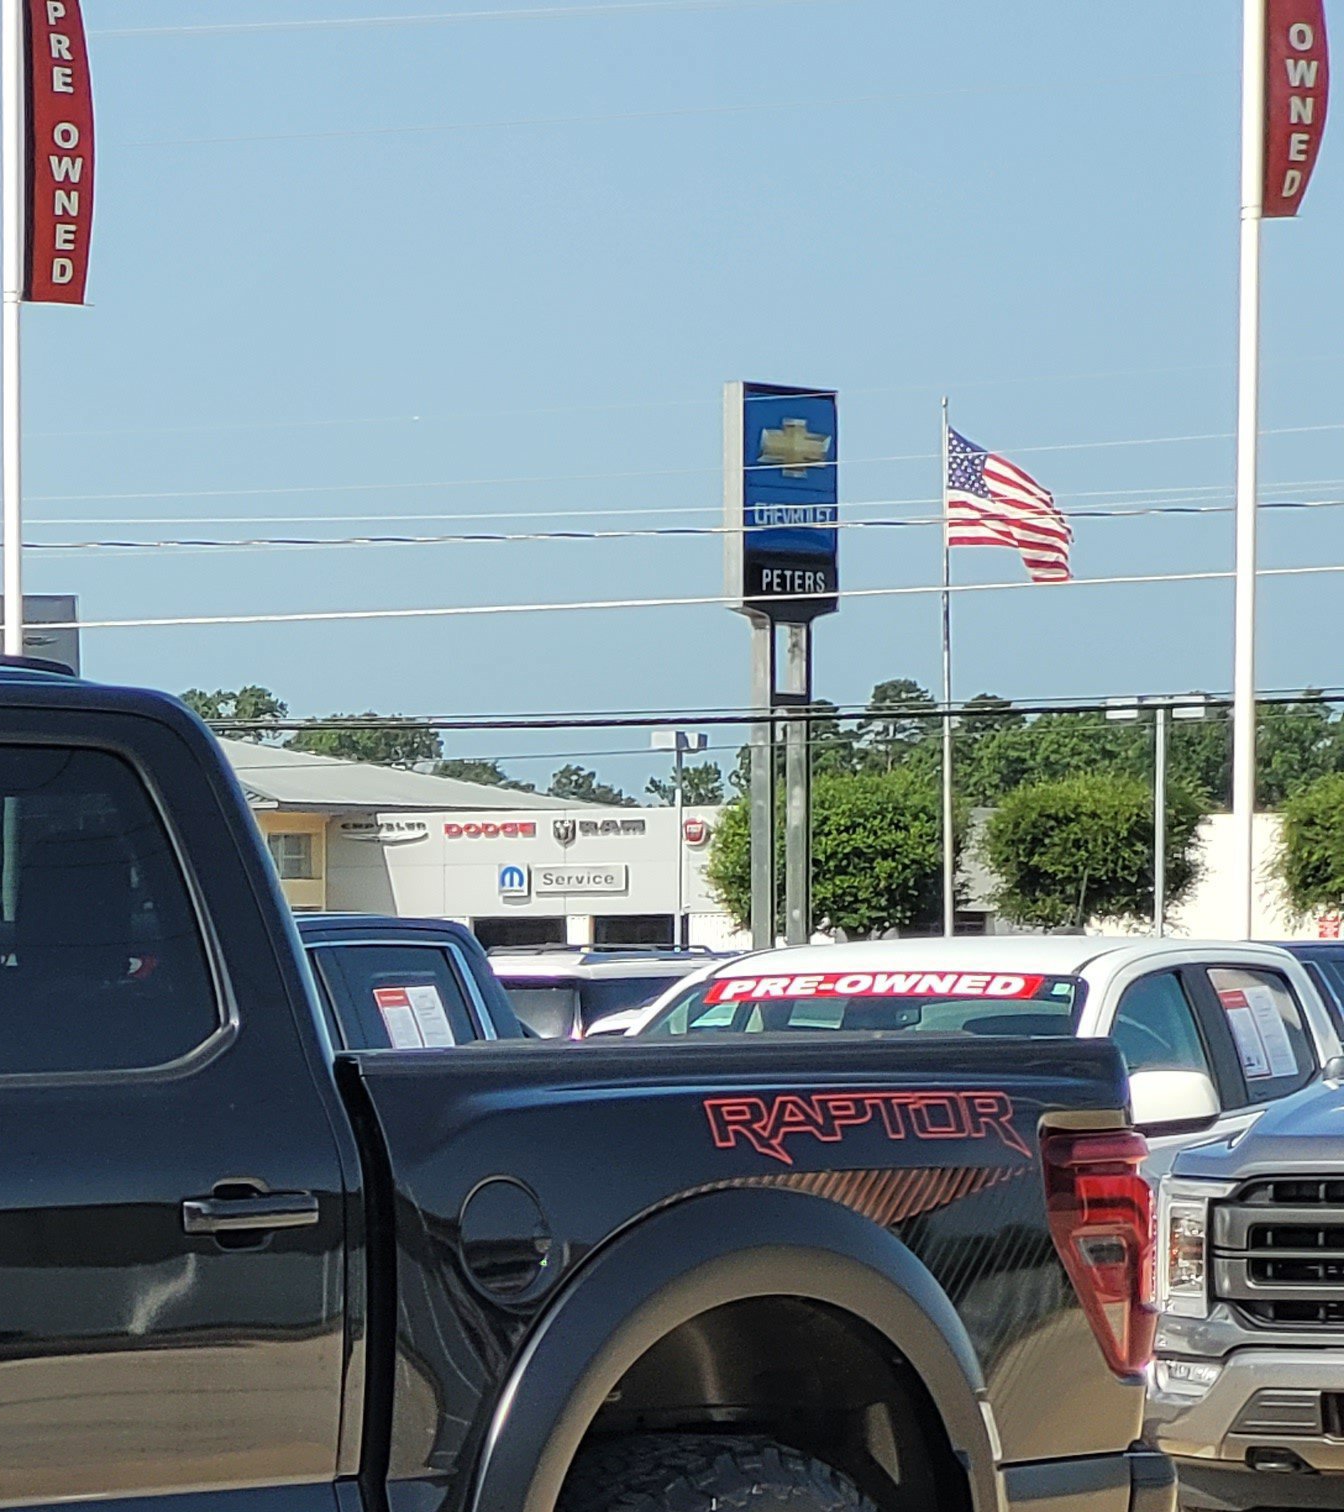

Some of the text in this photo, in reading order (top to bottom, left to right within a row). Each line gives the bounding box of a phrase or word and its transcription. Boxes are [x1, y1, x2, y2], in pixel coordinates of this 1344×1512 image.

[1281, 22, 1318, 198] OWNED
[47, 0, 83, 285] PRE OWNED
[761, 568, 826, 594] PETERS
[443, 821, 536, 838] DODGE
[578, 819, 647, 836] RAM
[541, 871, 616, 887] Service
[718, 973, 1026, 1001] PRE-OWNED
[703, 1090, 1034, 1166] RAPTOR
